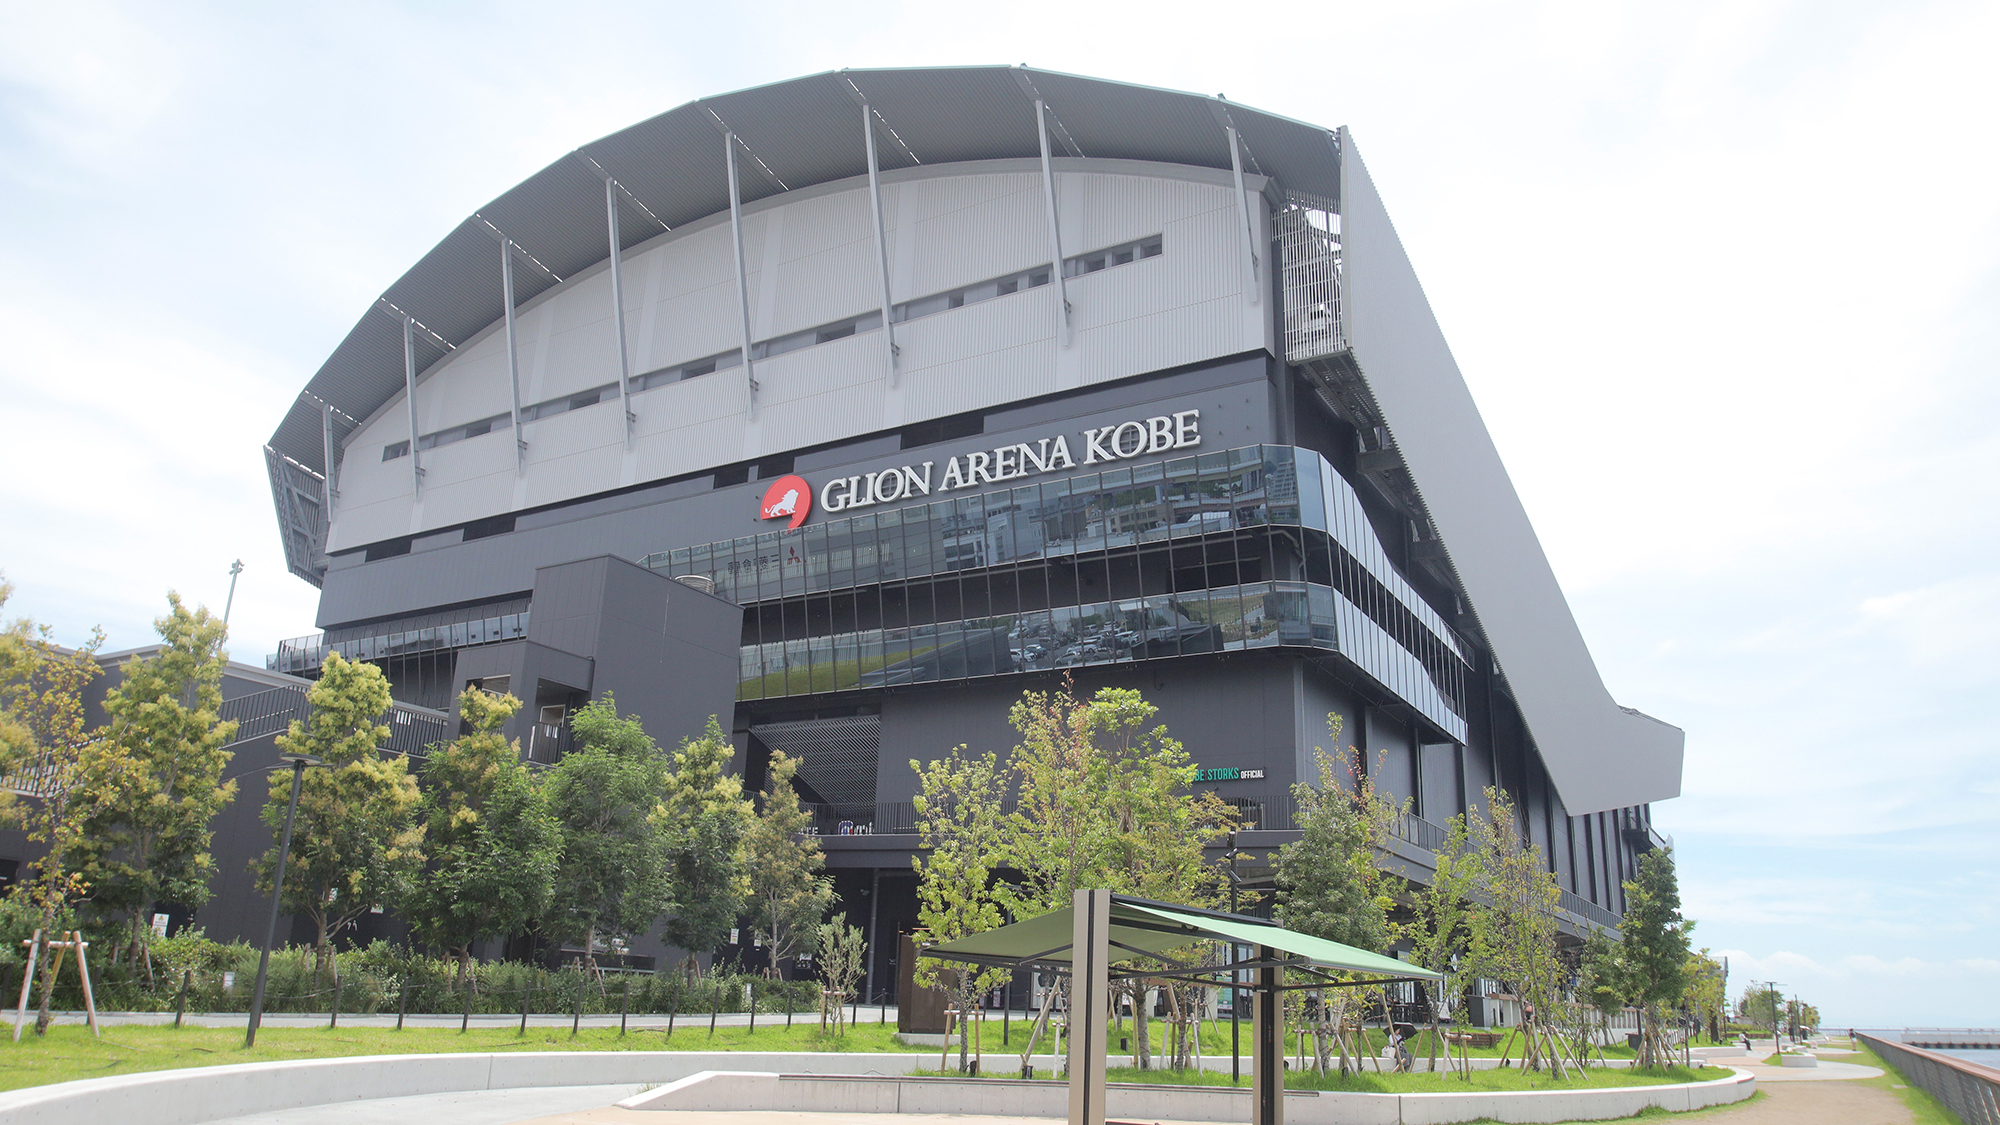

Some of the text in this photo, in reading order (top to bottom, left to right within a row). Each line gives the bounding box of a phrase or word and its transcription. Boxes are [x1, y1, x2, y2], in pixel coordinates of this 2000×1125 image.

[820, 409, 1201, 513] GLION ARENA KOBE
[1207, 767, 1240, 781] STORKS
[1240, 769, 1264, 779] OFFICIAL
